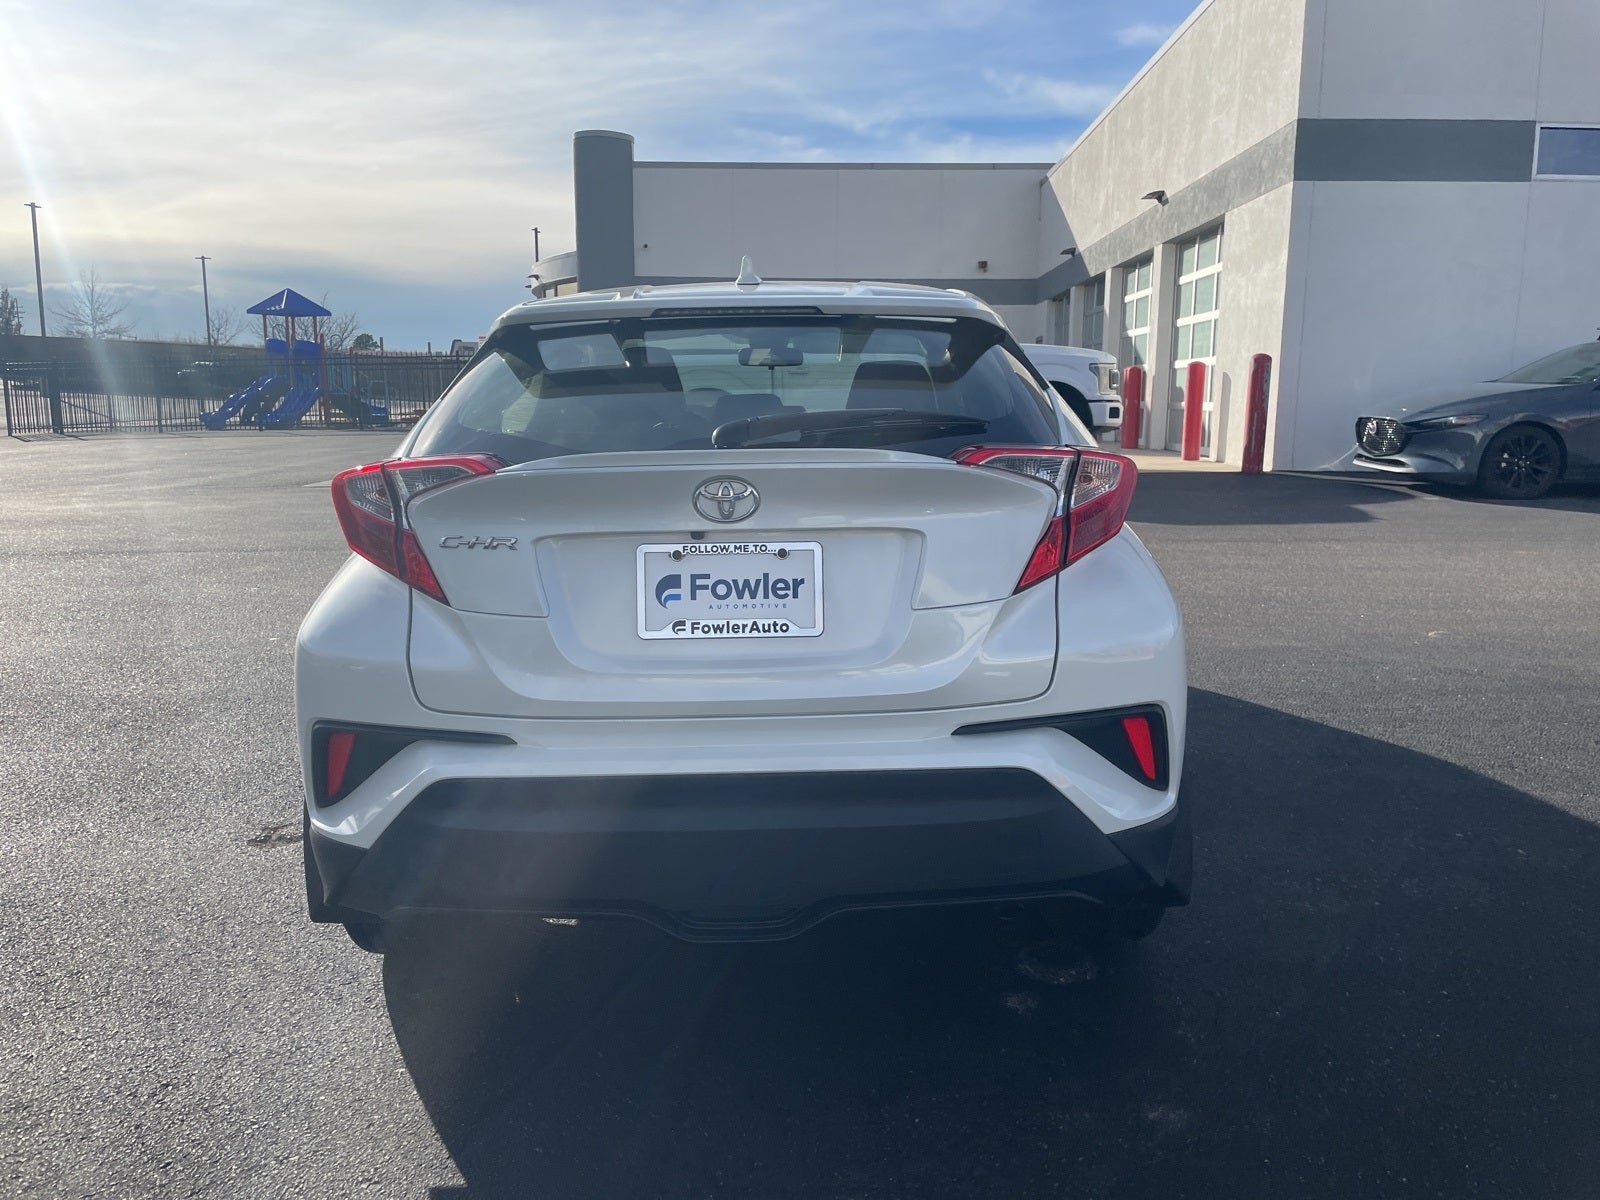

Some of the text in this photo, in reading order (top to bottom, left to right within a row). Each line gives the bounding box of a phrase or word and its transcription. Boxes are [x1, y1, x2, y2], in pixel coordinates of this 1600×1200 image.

[682, 545, 731, 554] FOLLOW
[733, 545, 750, 553] ME
[690, 572, 805, 601] Fowler
[690, 620, 790, 635] FowlerAuto
